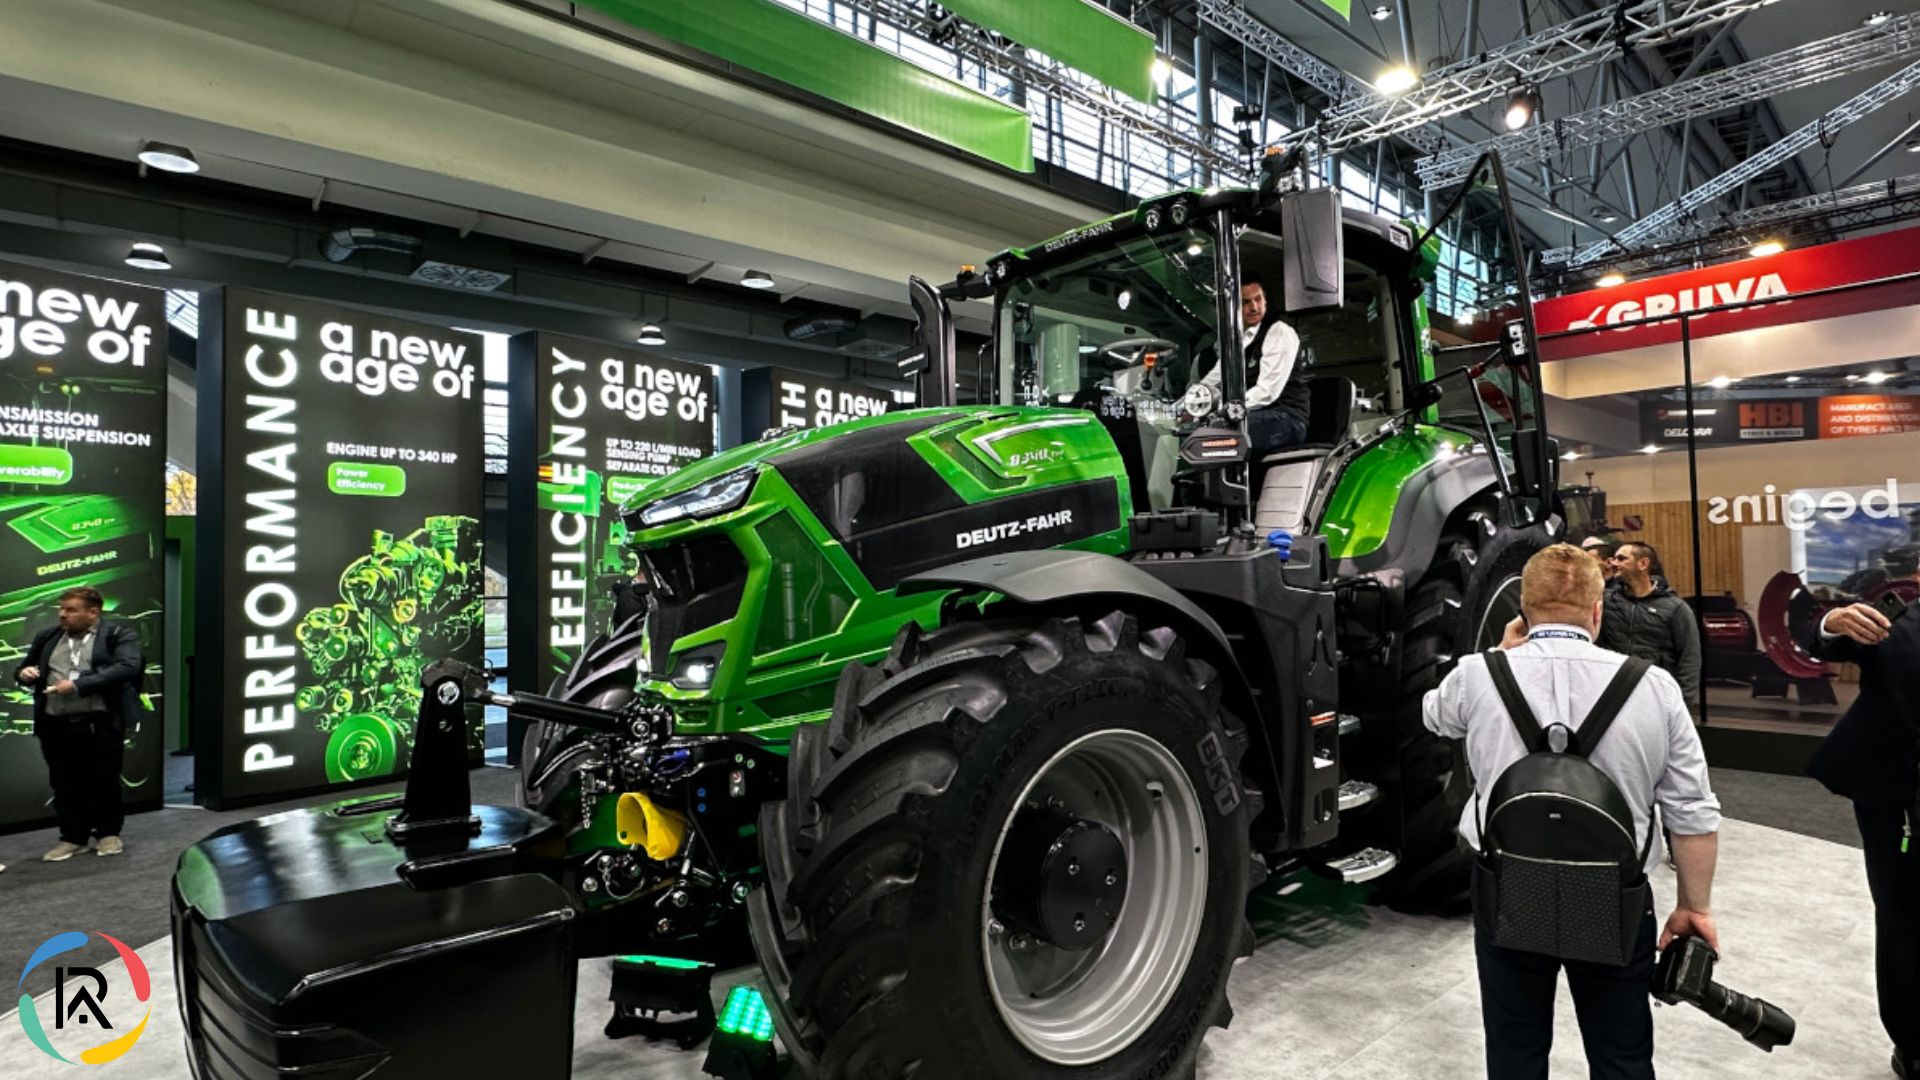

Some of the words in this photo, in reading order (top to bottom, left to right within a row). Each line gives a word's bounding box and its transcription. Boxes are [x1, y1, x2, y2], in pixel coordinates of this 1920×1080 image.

[1045, 222, 1113, 252] DEUTZ-FAHR
[1606, 273, 1792, 332] GRUVA
[87, 325, 152, 366] of
[320, 322, 353, 354] a
[371, 330, 466, 370] new
[320, 352, 419, 396] age
[433, 364, 474, 399] of
[600, 358, 624, 384] a
[635, 364, 701, 397] new
[600, 384, 669, 421] age
[677, 392, 708, 422] of
[815, 388, 832, 411] a
[839, 391, 888, 417] new
[1740, 403, 1804, 427] HBI
[43, 425, 151, 447] SUSPENSION
[620, 440, 633, 450] TO
[678, 446, 701, 459] LOAD
[326, 441, 378, 458] ENGINE
[380, 446, 397, 459] UP
[398, 448, 416, 460] TO
[417, 450, 439, 461] 340
[441, 452, 458, 464] HP
[606, 448, 646, 461] SENSING
[647, 453, 672, 464] PUMP
[335, 467, 368, 478] Power
[335, 478, 386, 491] Efficiency
[550, 347, 587, 646] EFFICIENCY
[245, 308, 297, 772] PERFORMANCE
[956, 509, 1073, 549] DEUTZ-FAHR
[37, 551, 118, 576] DEUTZ-FAHR
